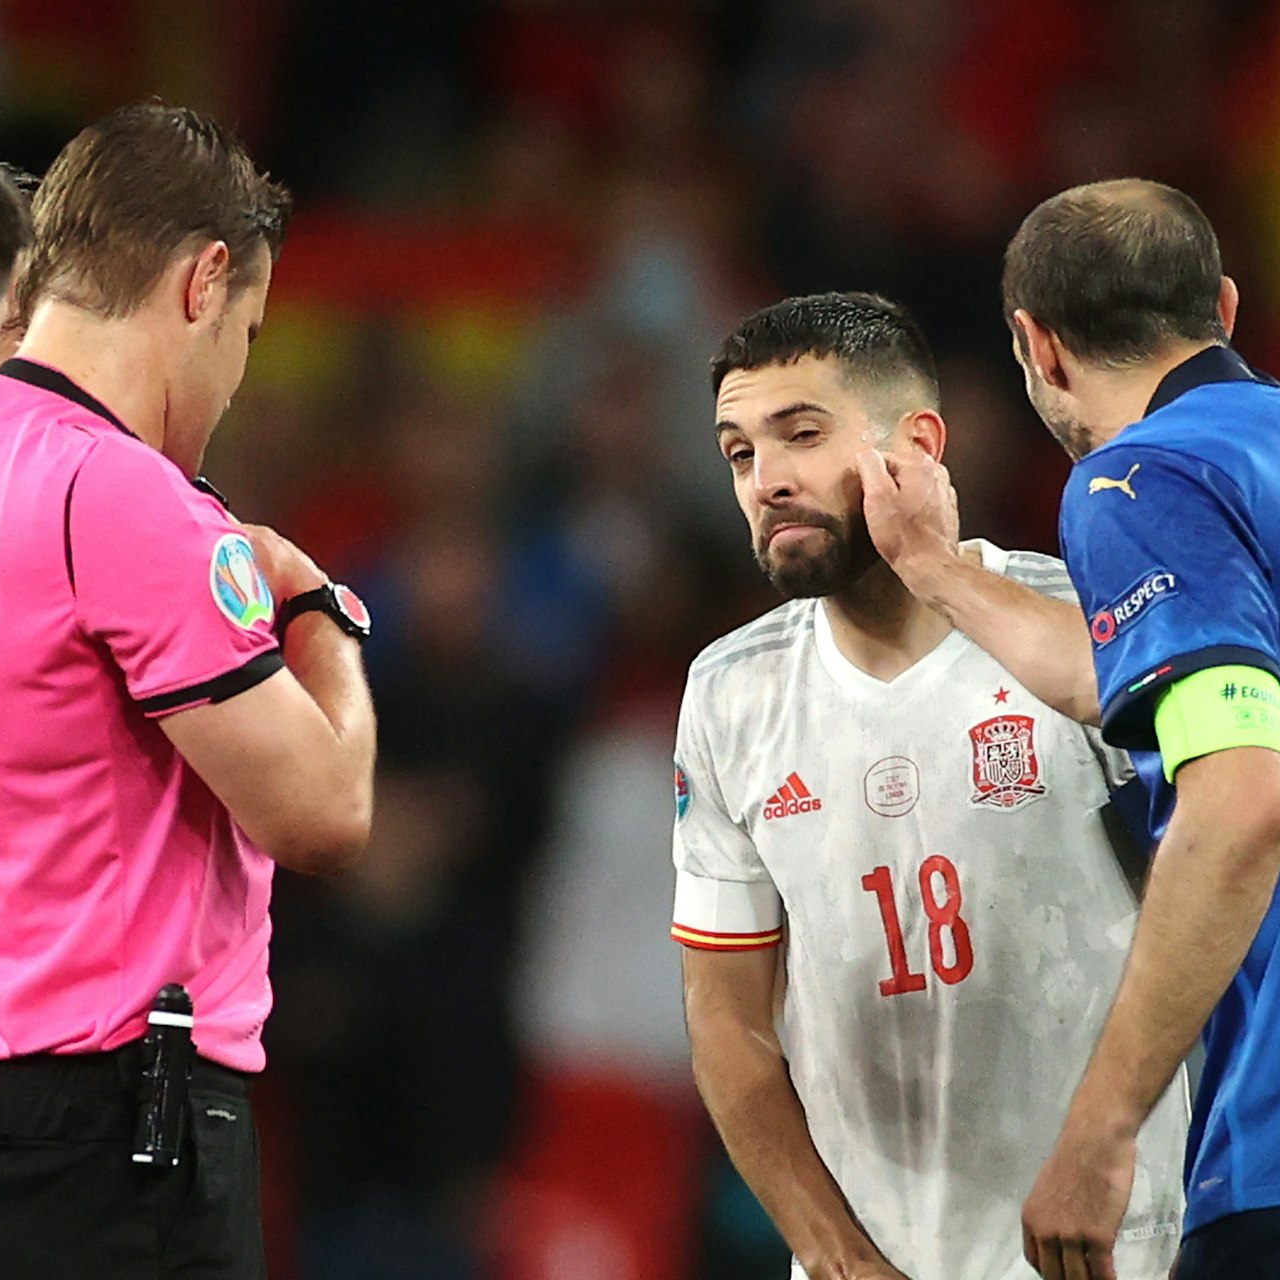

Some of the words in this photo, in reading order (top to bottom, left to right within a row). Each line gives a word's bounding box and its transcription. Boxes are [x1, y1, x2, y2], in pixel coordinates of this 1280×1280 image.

[1113, 573, 1175, 625] RESPECT
[763, 797, 822, 820] adidas
[862, 854, 974, 997] 18
